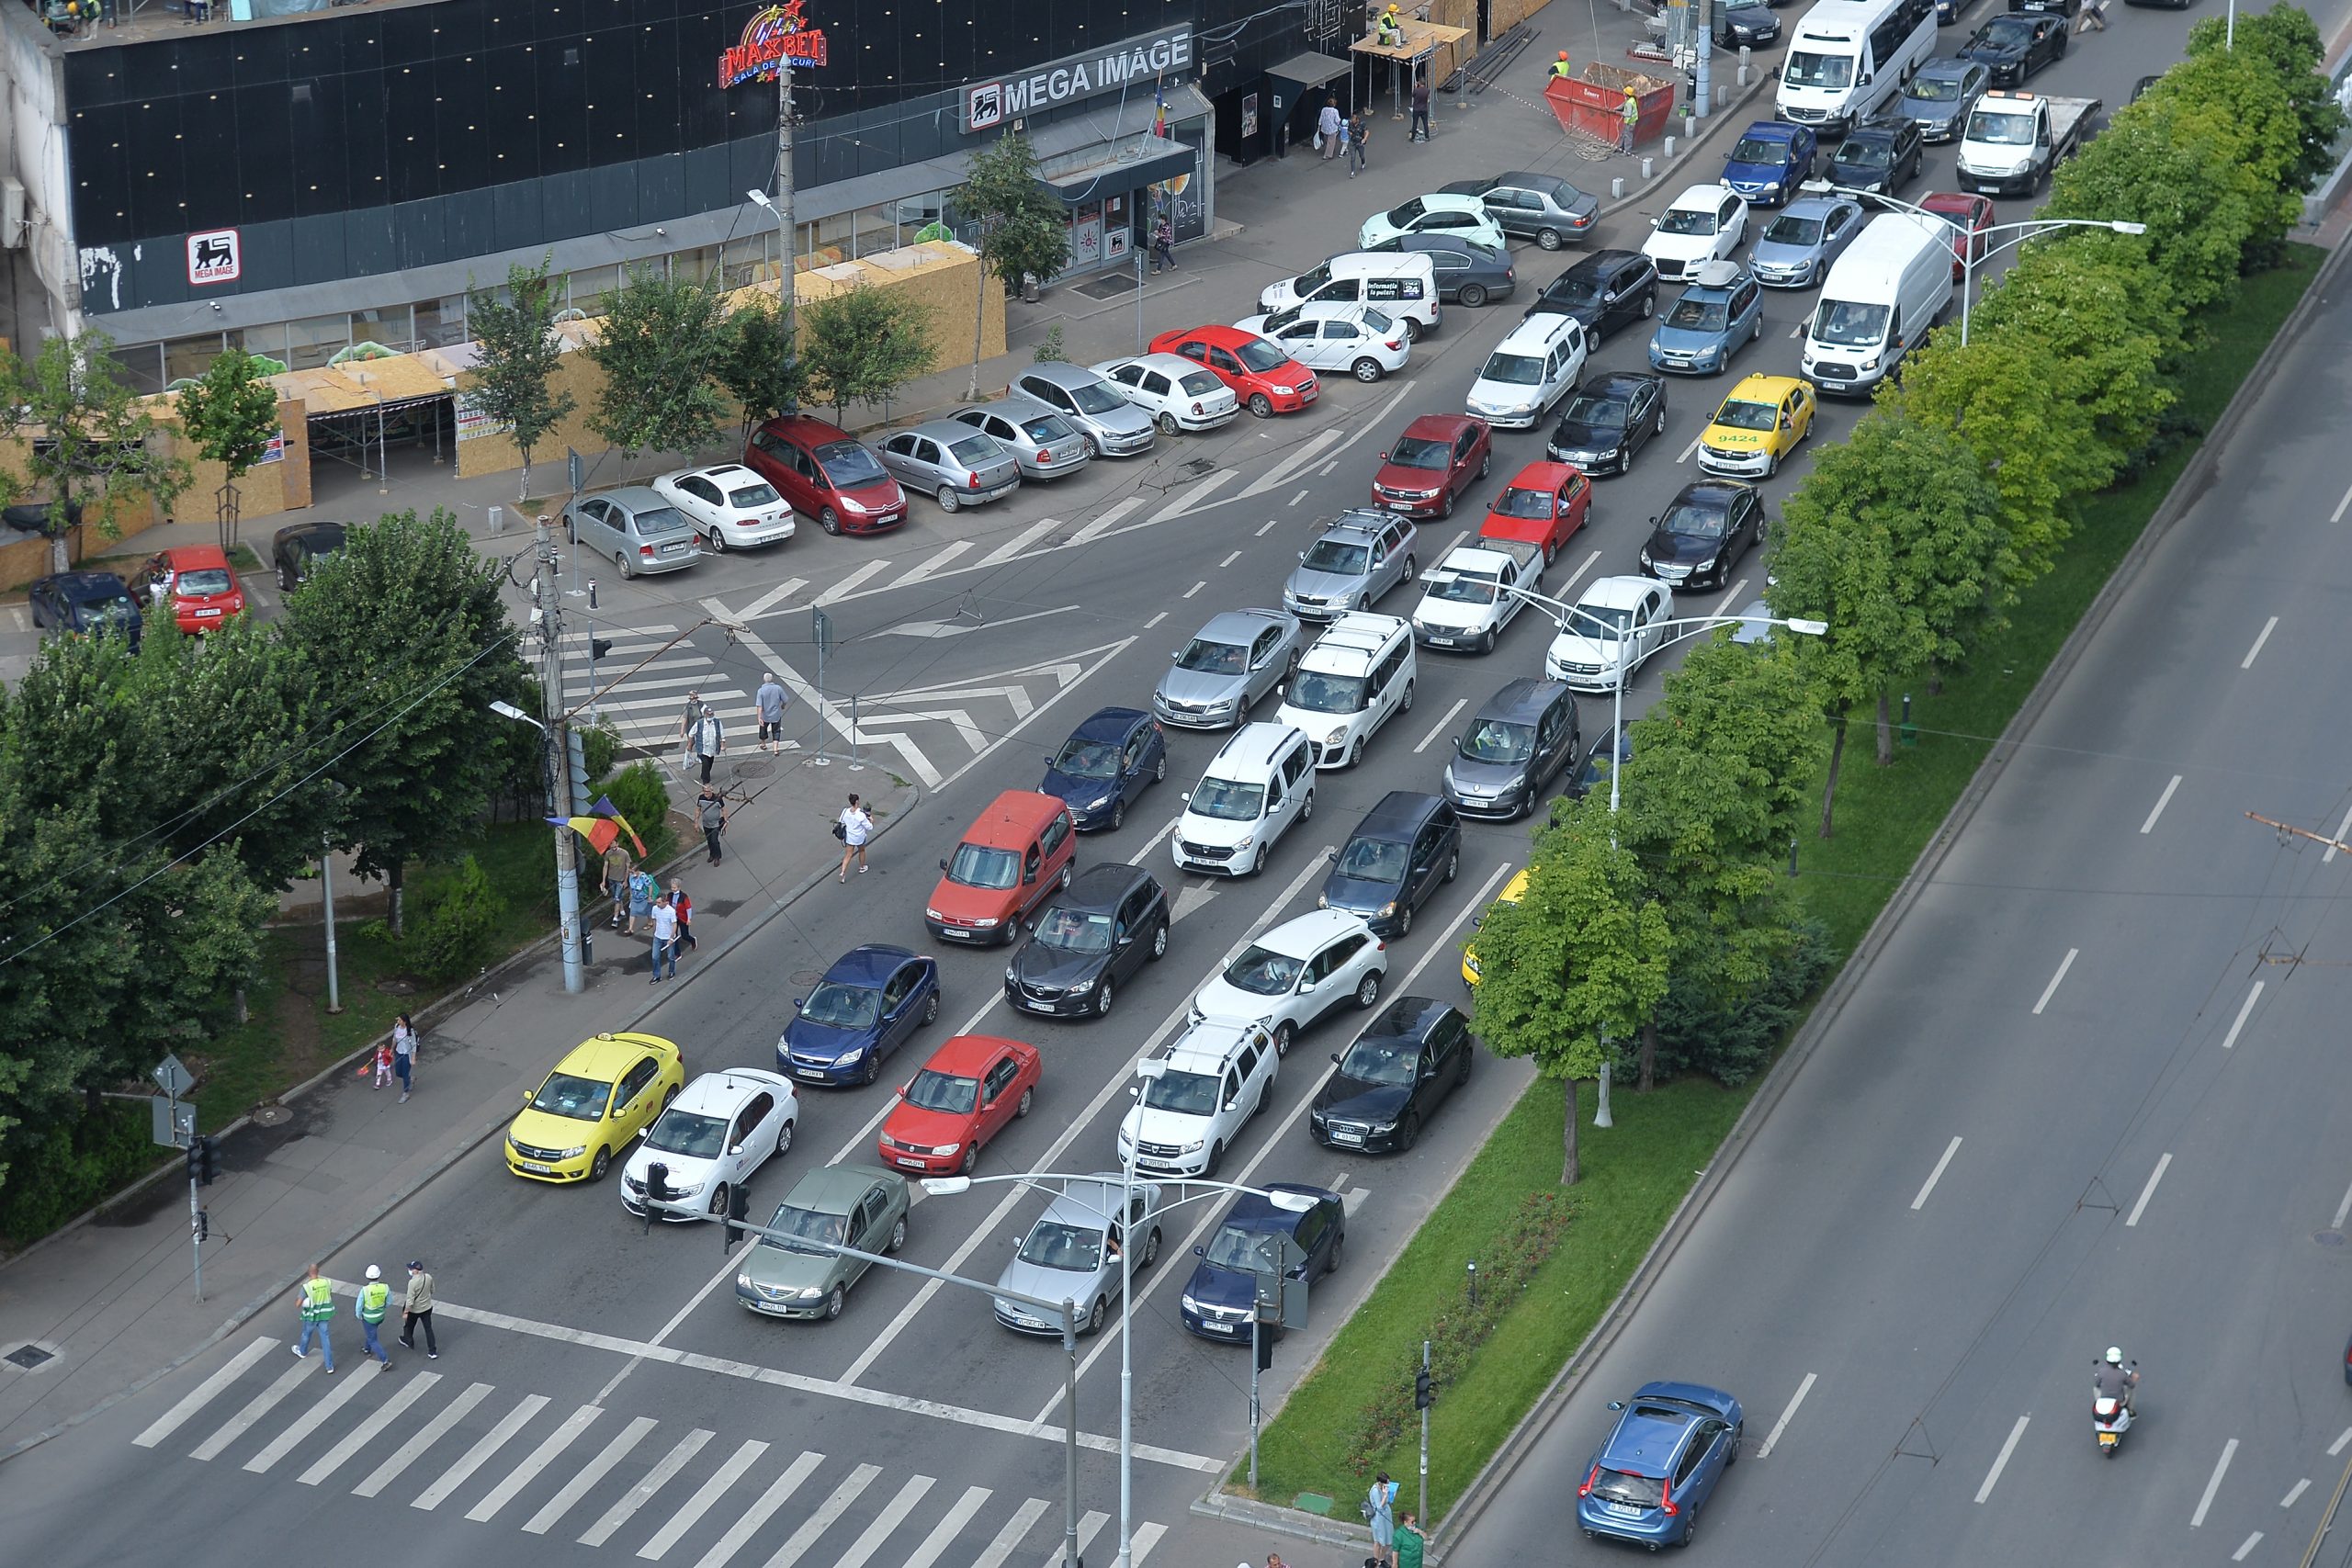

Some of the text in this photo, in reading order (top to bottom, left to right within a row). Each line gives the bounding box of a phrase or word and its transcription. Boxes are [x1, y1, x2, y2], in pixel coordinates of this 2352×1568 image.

[726, 29, 822, 79] MAXBET
[734, 67, 759, 85] SALA
[763, 61, 775, 71] DE
[1006, 32, 1189, 115] MEGA IMAGE
[195, 265, 233, 278] MEGA IMAGE
[1405, 286, 1419, 295] 24
